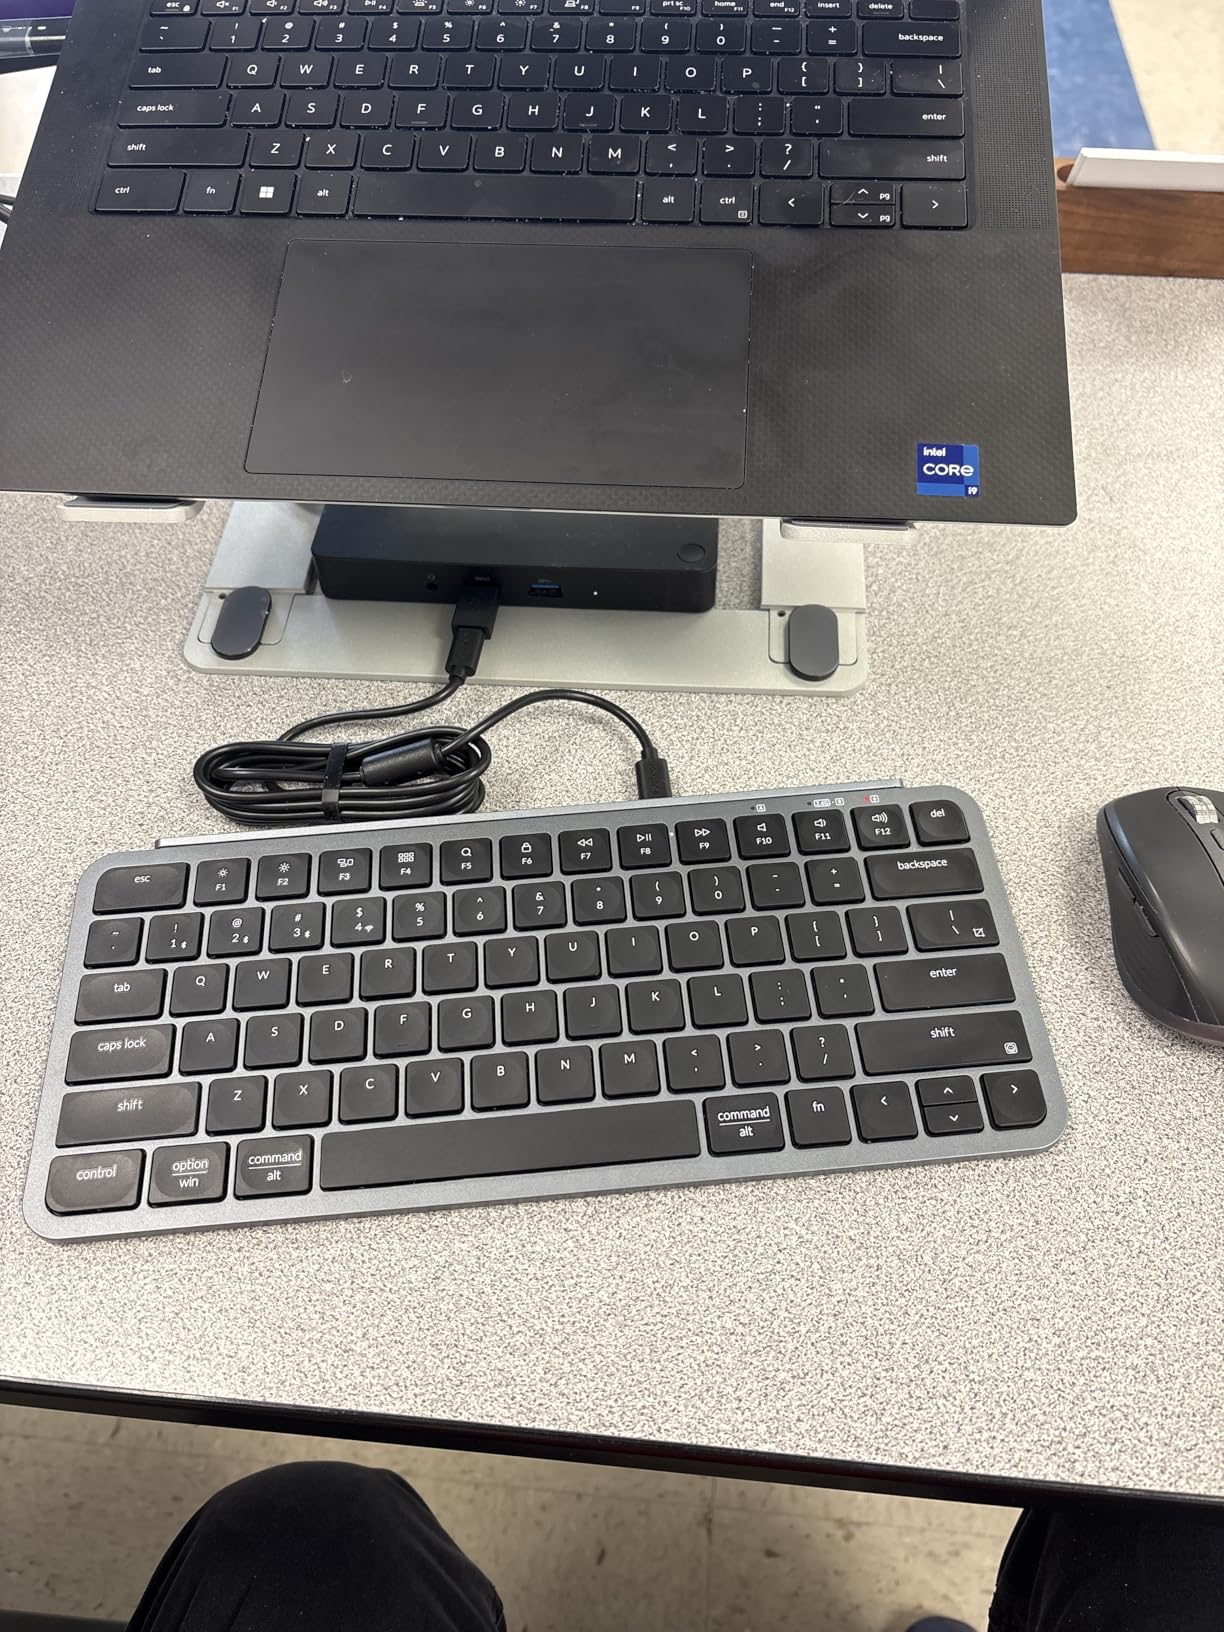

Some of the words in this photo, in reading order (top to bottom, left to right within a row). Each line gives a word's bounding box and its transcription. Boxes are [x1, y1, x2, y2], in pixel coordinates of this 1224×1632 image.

[282, 34, 290, 42] 2
[334, 34, 342, 42] 3
[388, 34, 396, 42] 4
[442, 34, 450, 42] 5
[496, 34, 504, 42] 6
[552, 34, 560, 42] 7
[606, 34, 614, 44] 8
[662, 36, 670, 44] 9
[898, 34, 944, 42] backspace
[246, 64, 258, 76] Q
[300, 64, 314, 74] W
[356, 64, 364, 74] E
[408, 64, 418, 74] R
[466, 64, 474, 74] T
[520, 66, 530, 76] Y
[574, 66, 584, 76] U
[742, 68, 752, 78] P
[158, 104, 174, 112] lock
[250, 102, 262, 112] A
[306, 102, 316, 114] S
[362, 102, 372, 114] D
[416, 104, 426, 114] F
[472, 104, 482, 116] G
[528, 104, 538, 116] H
[586, 106, 594, 116] J
[640, 106, 650, 118] K
[698, 108, 706, 118] L
[270, 142, 280, 154] Z
[326, 144, 336, 154] X
[382, 144, 392, 156] C
[440, 144, 450, 156] V
[494, 146, 504, 158] B
[552, 146, 562, 158] N
[608, 148, 622, 158] M
[926, 154, 948, 162] shift
[206, 186, 216, 194] fn
[316, 188, 328, 196] alt
[662, 196, 674, 204] alt
[720, 196, 736, 204] ctrl
[922, 446, 946, 456] intel
[922, 462, 974, 477] CORe
[968, 486, 978, 496] i9
[930, 808, 946, 818] del
[814, 832, 832, 840] F11
[874, 828, 892, 836] F12
[756, 836, 772, 844] F10
[700, 842, 710, 850] F9
[462, 862, 472, 870] F5
[896, 860, 948, 870] backspace
[338, 872, 350, 880] F3
[400, 868, 412, 876] F4
[134, 876, 150, 884] esc
[276, 878, 288, 886] F2
[216, 884, 226, 892] F1
[596, 900, 604, 910] 8
[656, 896, 662, 904] 9
[536, 906, 544, 914] 7
[416, 916, 424, 926] 5
[476, 912, 484, 920] 6
[354, 922, 362, 932] 4
[750, 926, 758, 936] P
[232, 934, 240, 942] 2
[294, 928, 300, 938] 3
[508, 948, 516, 956] Y
[568, 942, 578, 952] U
[446, 952, 454, 962] T
[384, 958, 392, 968] R
[322, 964, 330, 974] E
[930, 968, 956, 978] enter
[256, 970, 270, 980] W
[196, 976, 206, 986] Q
[114, 982, 130, 992] tab
[714, 986, 722, 996] L
[652, 992, 660, 1002] K
[526, 1002, 534, 1012] H
[462, 1008, 472, 1018] G
[400, 1014, 408, 1024] F
[334, 1020, 344, 1030] D
[272, 1026, 278, 1036] S
[930, 1026, 956, 1038] shift
[206, 1032, 216, 1042] A
[98, 1042, 122, 1052] caps
[124, 1036, 146, 1048] lock
[624, 1054, 636, 1064] M
[560, 1060, 570, 1070] N
[496, 1066, 504, 1076] B
[430, 1072, 440, 1082] V
[366, 1078, 374, 1090] C
[234, 1090, 242, 1100] Z
[300, 1084, 308, 1096] X
[118, 1098, 142, 1112] shift
[812, 1100, 824, 1112] fn
[718, 1106, 770, 1122] command
[740, 1126, 754, 1136] alt
[248, 1150, 302, 1164] command
[172, 1158, 210, 1172] option
[76, 1164, 118, 1180] control
[266, 1170, 282, 1182] alt
[178, 1176, 198, 1188] win
